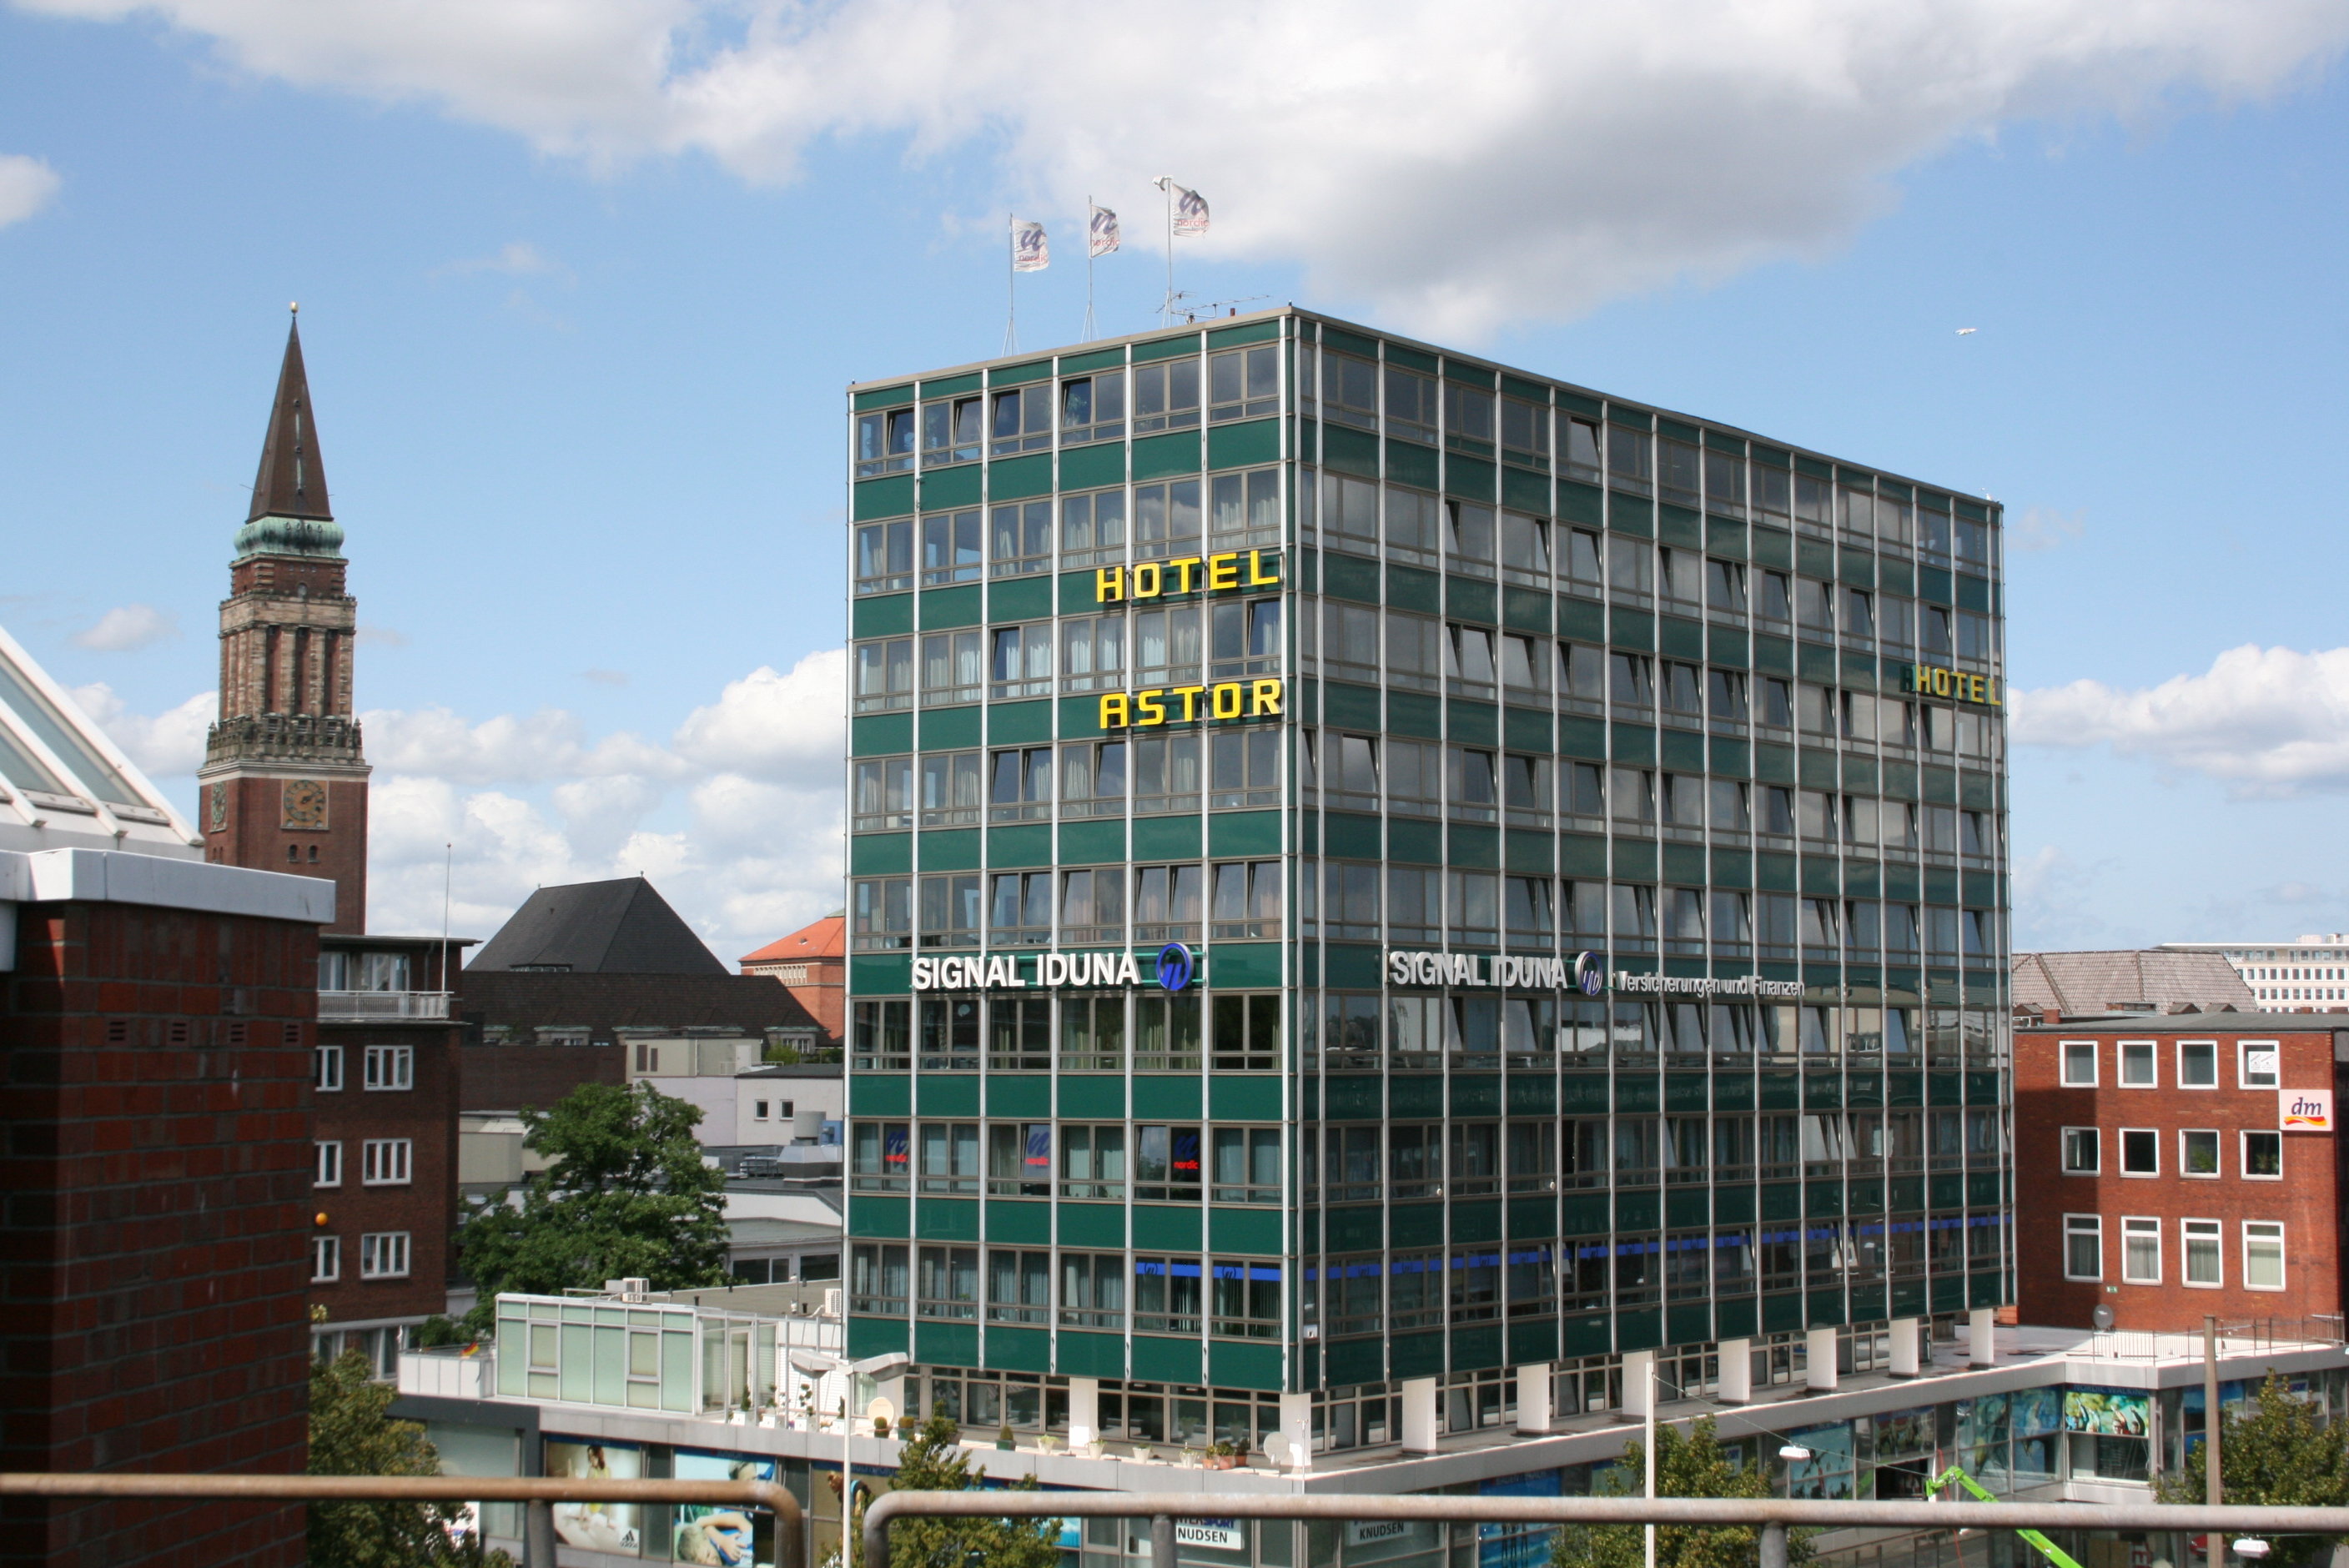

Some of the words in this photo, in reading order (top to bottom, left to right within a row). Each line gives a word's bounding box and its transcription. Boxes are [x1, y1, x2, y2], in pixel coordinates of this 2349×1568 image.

[1177, 219, 1209, 227] nordic
[1096, 550, 1280, 603] HOTEL
[1913, 664, 2002, 706] HOTEL
[1099, 678, 1282, 729] ASTOR
[912, 955, 1025, 990] SIGNAL
[1037, 952, 1141, 987] IDUNA
[1391, 951, 1486, 985] SIGNAL
[1491, 955, 1568, 988] IDUNA
[1617, 971, 1721, 998] Versicherungen
[1723, 975, 1748, 994] und
[1751, 976, 1805, 996] Finanzen
[2291, 1097, 2322, 1116] dm
[1174, 1160, 1200, 1170] nordic
[1178, 1526, 1228, 1544] NUDSEN
[1360, 1522, 1405, 1540] KNUDSEN
